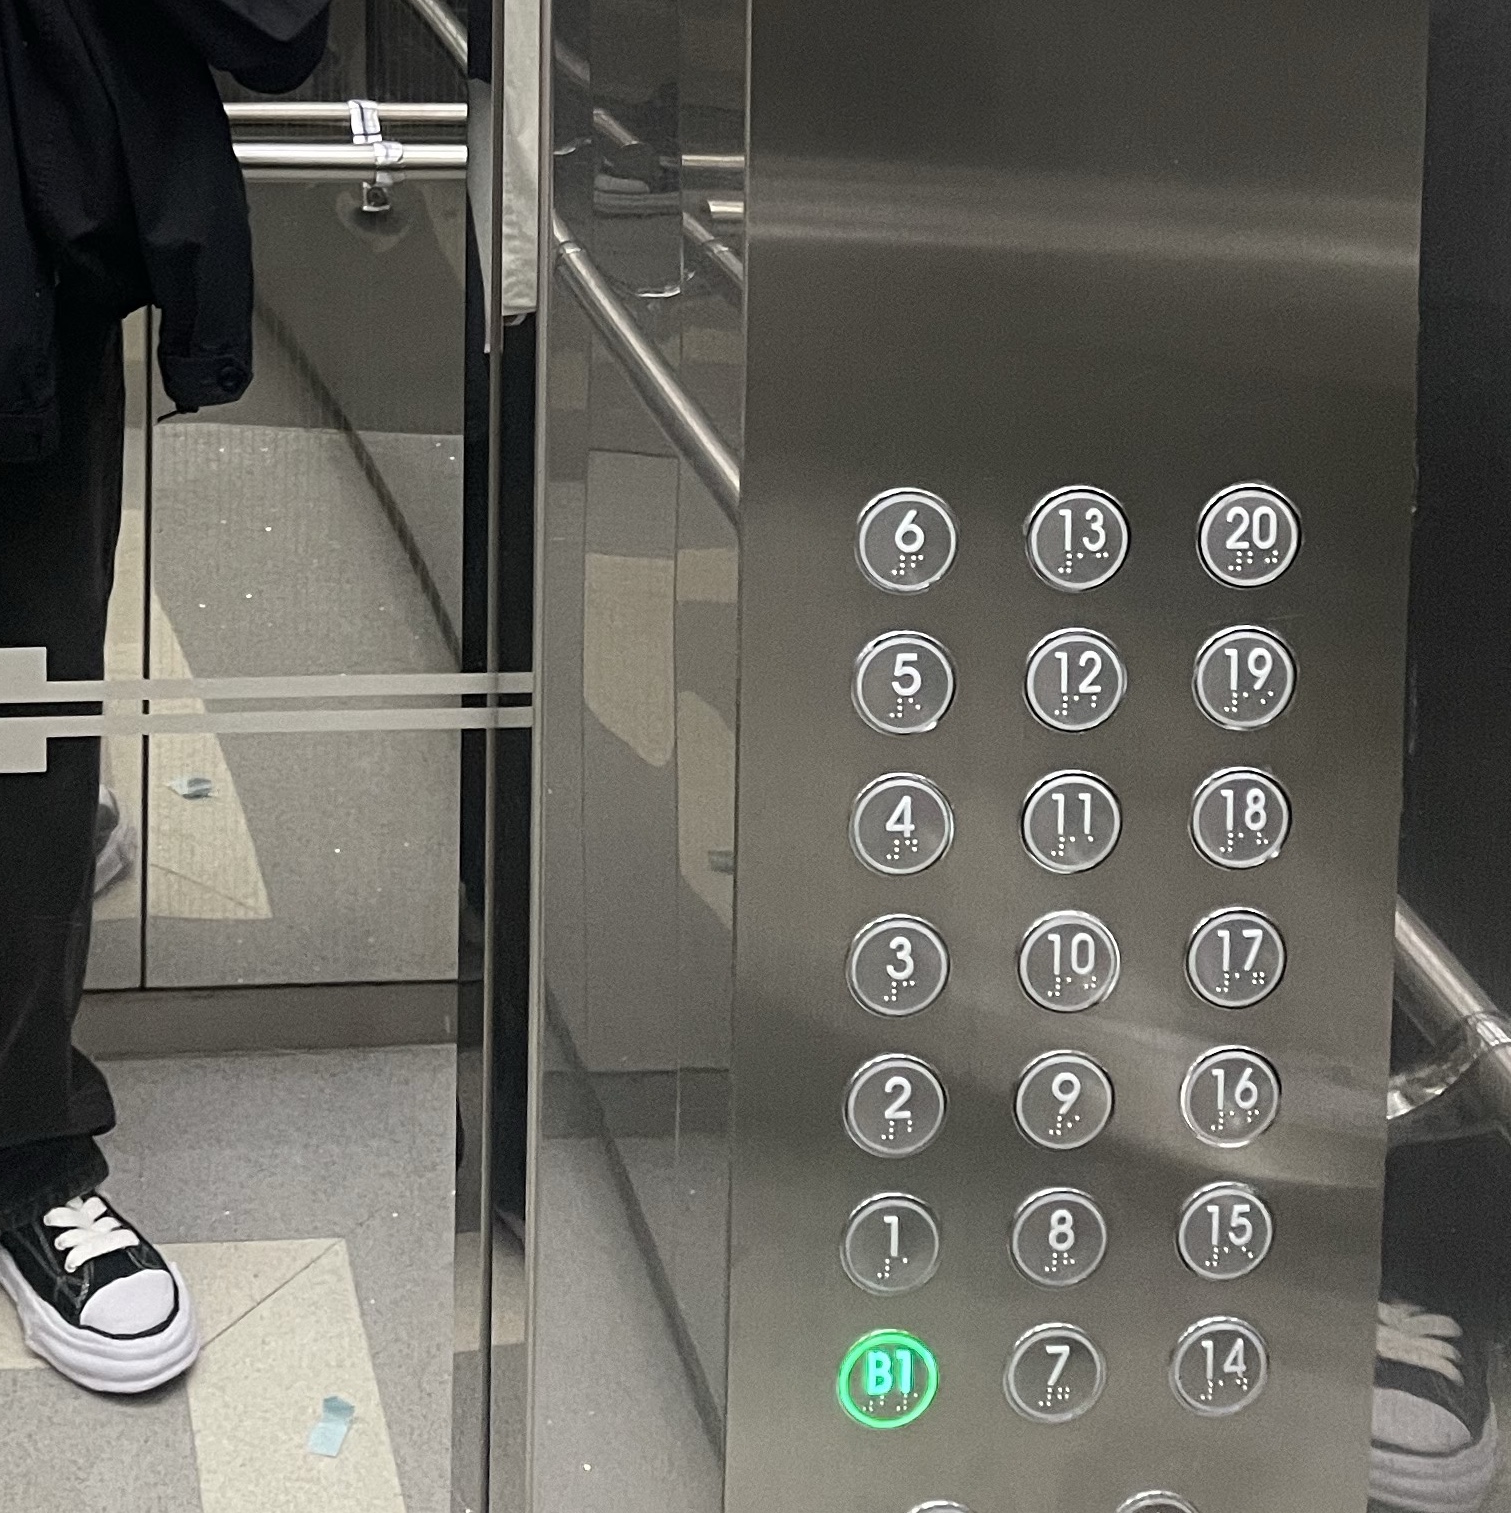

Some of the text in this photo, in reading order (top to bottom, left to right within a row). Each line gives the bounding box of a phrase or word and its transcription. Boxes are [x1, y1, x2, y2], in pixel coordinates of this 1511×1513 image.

[895, 509, 925, 553] 6
[1059, 507, 1106, 552] 13
[1225, 505, 1278, 550] 20
[891, 652, 922, 696] 5
[1054, 650, 1102, 694] 12
[1224, 647, 1273, 691] 19
[885, 795, 916, 838] 4
[1051, 792, 1092, 835] 11
[1220, 787, 1267, 832] 18
[886, 936, 915, 980] 3
[1047, 932, 1096, 976] 10
[1216, 928, 1263, 972] 17
[884, 1075, 912, 1120] 2
[1051, 1071, 1081, 1115] 9
[1211, 1067, 1258, 1111] 16
[883, 1215, 899, 1258] 1
[1048, 1208, 1075, 1252] 8
[1206, 1203, 1253, 1246] 15
[867, 1350, 914, 1396] B1
[1045, 1344, 1070, 1386] 7
[1201, 1337, 1248, 1383] 14
